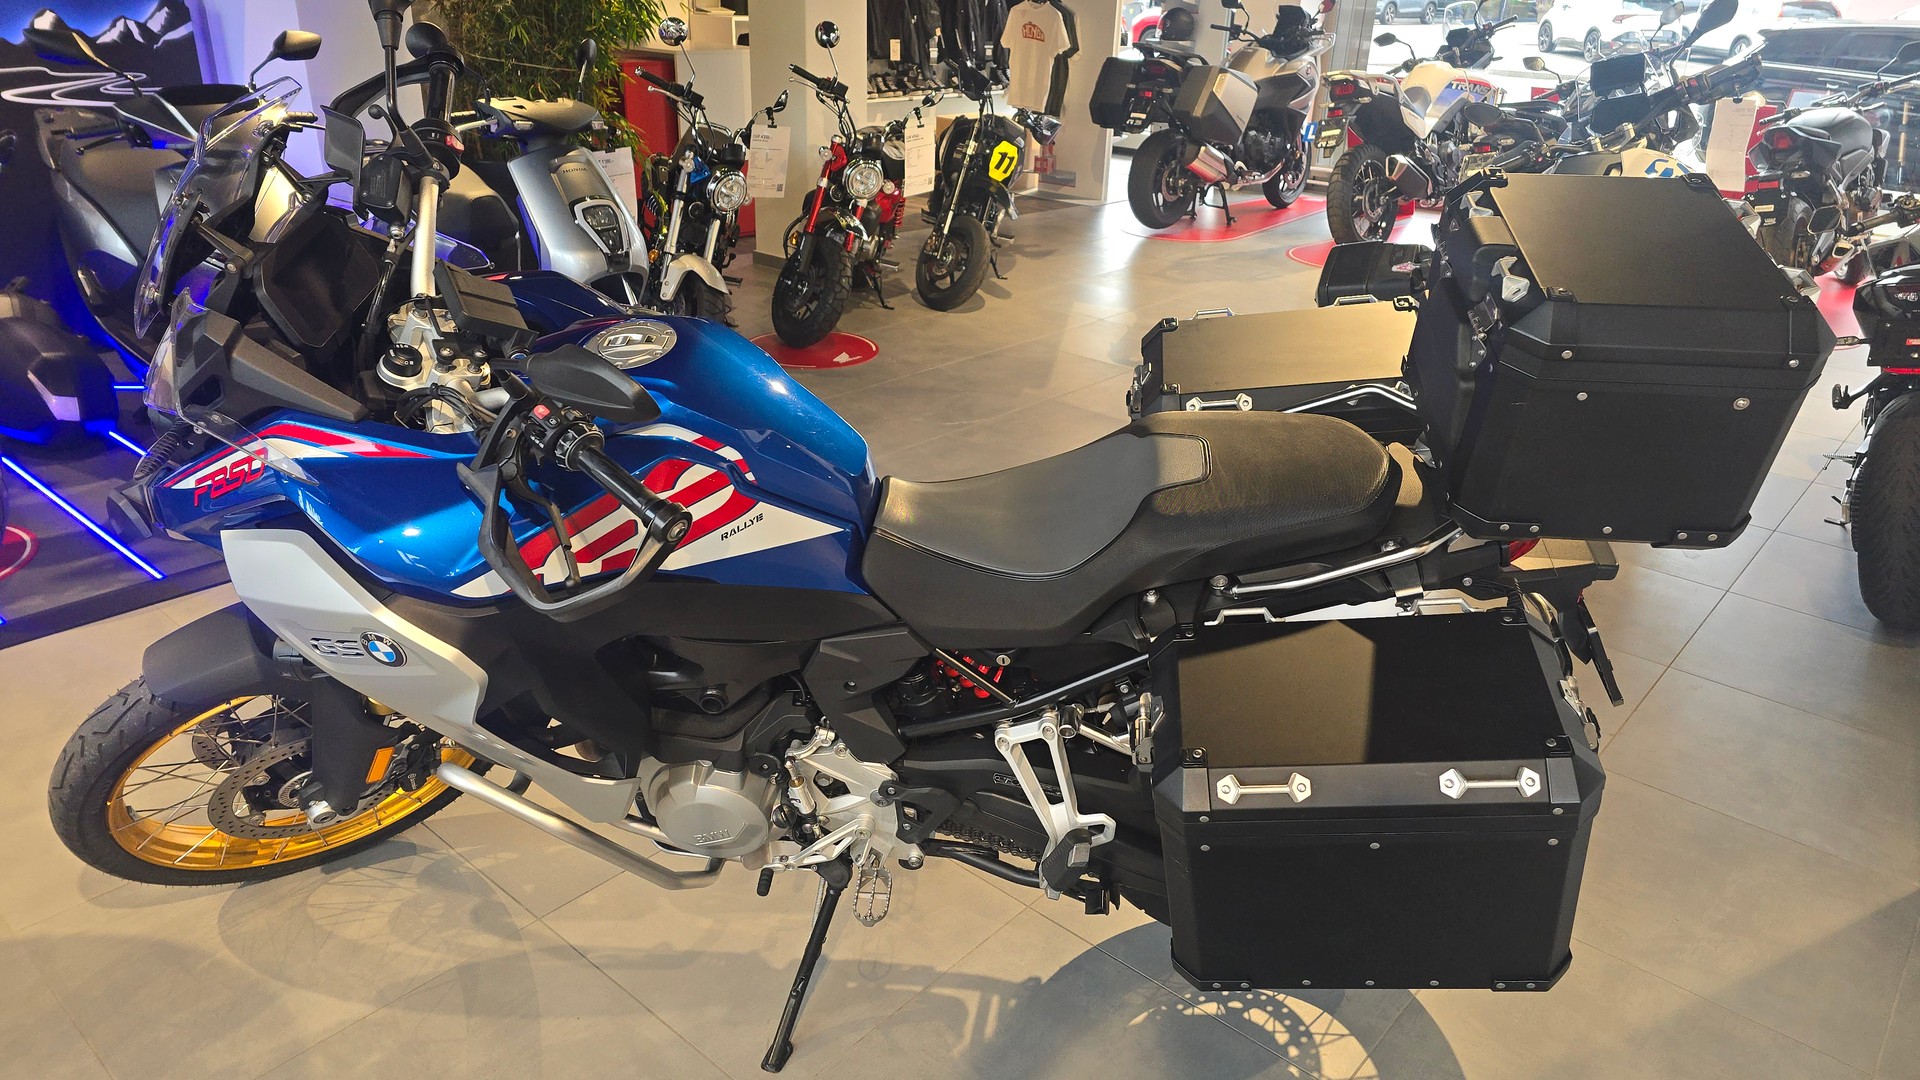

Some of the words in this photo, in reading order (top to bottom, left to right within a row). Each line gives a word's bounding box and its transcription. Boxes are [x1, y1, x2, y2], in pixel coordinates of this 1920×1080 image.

[994, 152, 1015, 174] 11
[720, 512, 764, 541] RALLYE
[310, 637, 365, 658] GS
